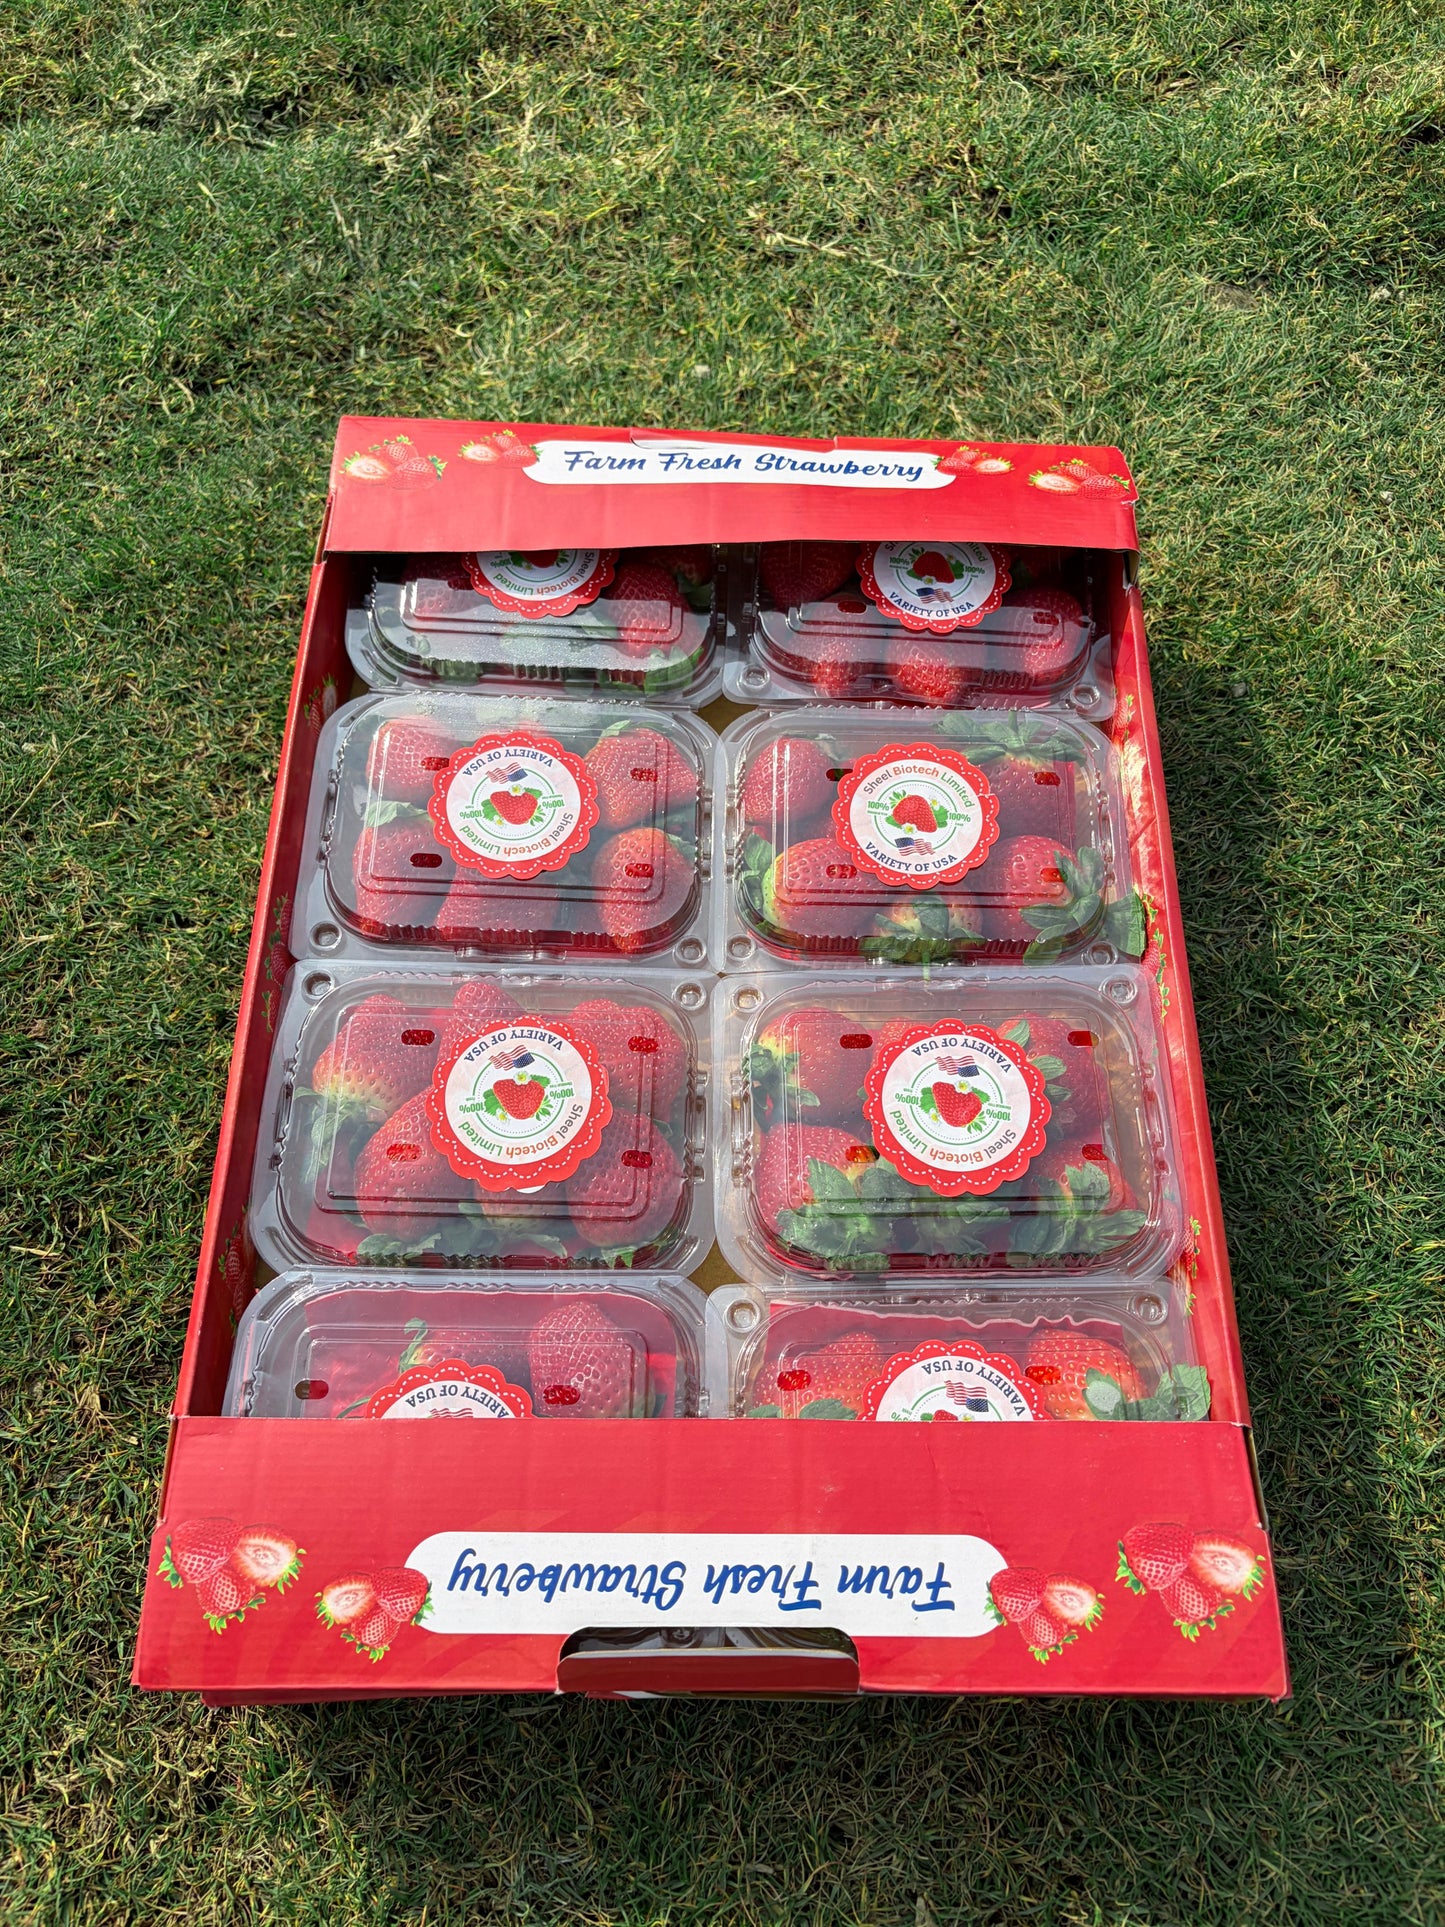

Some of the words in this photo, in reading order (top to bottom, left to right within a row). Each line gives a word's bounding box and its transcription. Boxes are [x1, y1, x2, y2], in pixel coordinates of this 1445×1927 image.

[564, 450, 645, 471] Farm
[658, 451, 742, 472] Fresh
[755, 452, 924, 482] Strawberry
[579, 551, 595, 579] Sheel
[889, 556, 910, 566] 100%
[965, 565, 986, 574] 100%
[493, 573, 534, 596] Limited
[536, 575, 580, 595] Biotech
[890, 591, 933, 617] VARIETY
[935, 609, 950, 618] OF
[951, 601, 975, 615] USA
[487, 750, 502, 762] OF
[504, 748, 554, 767] VARIETY
[462, 757, 487, 777] USA
[863, 770, 893, 795] Sheel
[892, 764, 940, 778] Biotech
[940, 771, 976, 808] Limited
[542, 799, 565, 809] 100%
[867, 800, 890, 811] 100%
[459, 809, 483, 820] 100%
[948, 812, 971, 823] 100%
[549, 812, 574, 842] Sheel
[459, 825, 501, 855] Limited
[503, 837, 552, 857] Biotech
[865, 842, 912, 872] VARIETY
[914, 862, 930, 872] OF
[931, 854, 958, 870] USA
[491, 1032, 507, 1046] OF
[510, 1029, 564, 1051] VARIETY
[911, 1039, 940, 1057] USA
[941, 1037, 958, 1047] OF
[463, 1041, 490, 1062] USA
[961, 1039, 1012, 1074] VARIETY
[549, 1087, 574, 1099] 100%
[895, 1092, 919, 1105] 100%
[459, 1102, 484, 1114] 100%
[985, 1108, 1011, 1121] 100%
[559, 1103, 584, 1139] Sheel
[458, 1121, 503, 1157] Limited
[889, 1109, 929, 1154] Limited
[505, 1134, 559, 1159] Biotech
[987, 1129, 1017, 1159] Sheel
[929, 1147, 984, 1164] Biotech
[921, 1360, 951, 1375] USA
[955, 1360, 974, 1373] OF
[405, 1387, 437, 1408] USA
[439, 1384, 458, 1396] OF
[975, 1366, 1026, 1417] VARIETY
[461, 1386, 510, 1418] ARIETY
[447, 1548, 686, 1611] Strawberry
[704, 1560, 823, 1611] Fresh
[837, 1561, 956, 1612] Farm
